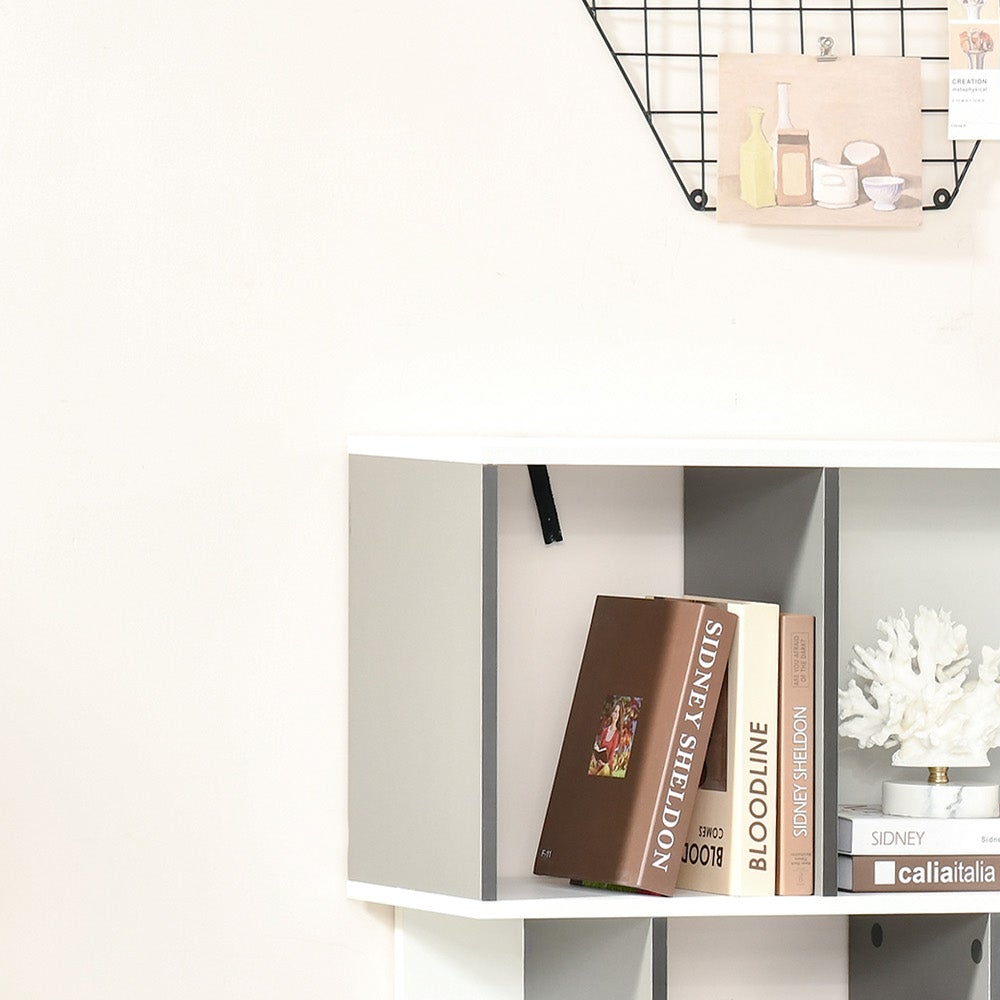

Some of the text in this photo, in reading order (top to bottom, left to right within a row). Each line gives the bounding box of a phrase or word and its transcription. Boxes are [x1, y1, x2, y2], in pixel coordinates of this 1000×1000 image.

[651, 619, 724, 873] SIDNEY SHELDON
[793, 706, 808, 782] SHELDON
[749, 721, 768, 871] BLOODLINE
[793, 788, 808, 838] SIDNEY
[698, 825, 724, 840] COMES
[871, 831, 925, 847] SIDNEY
[898, 860, 996, 884] caliaitalia
